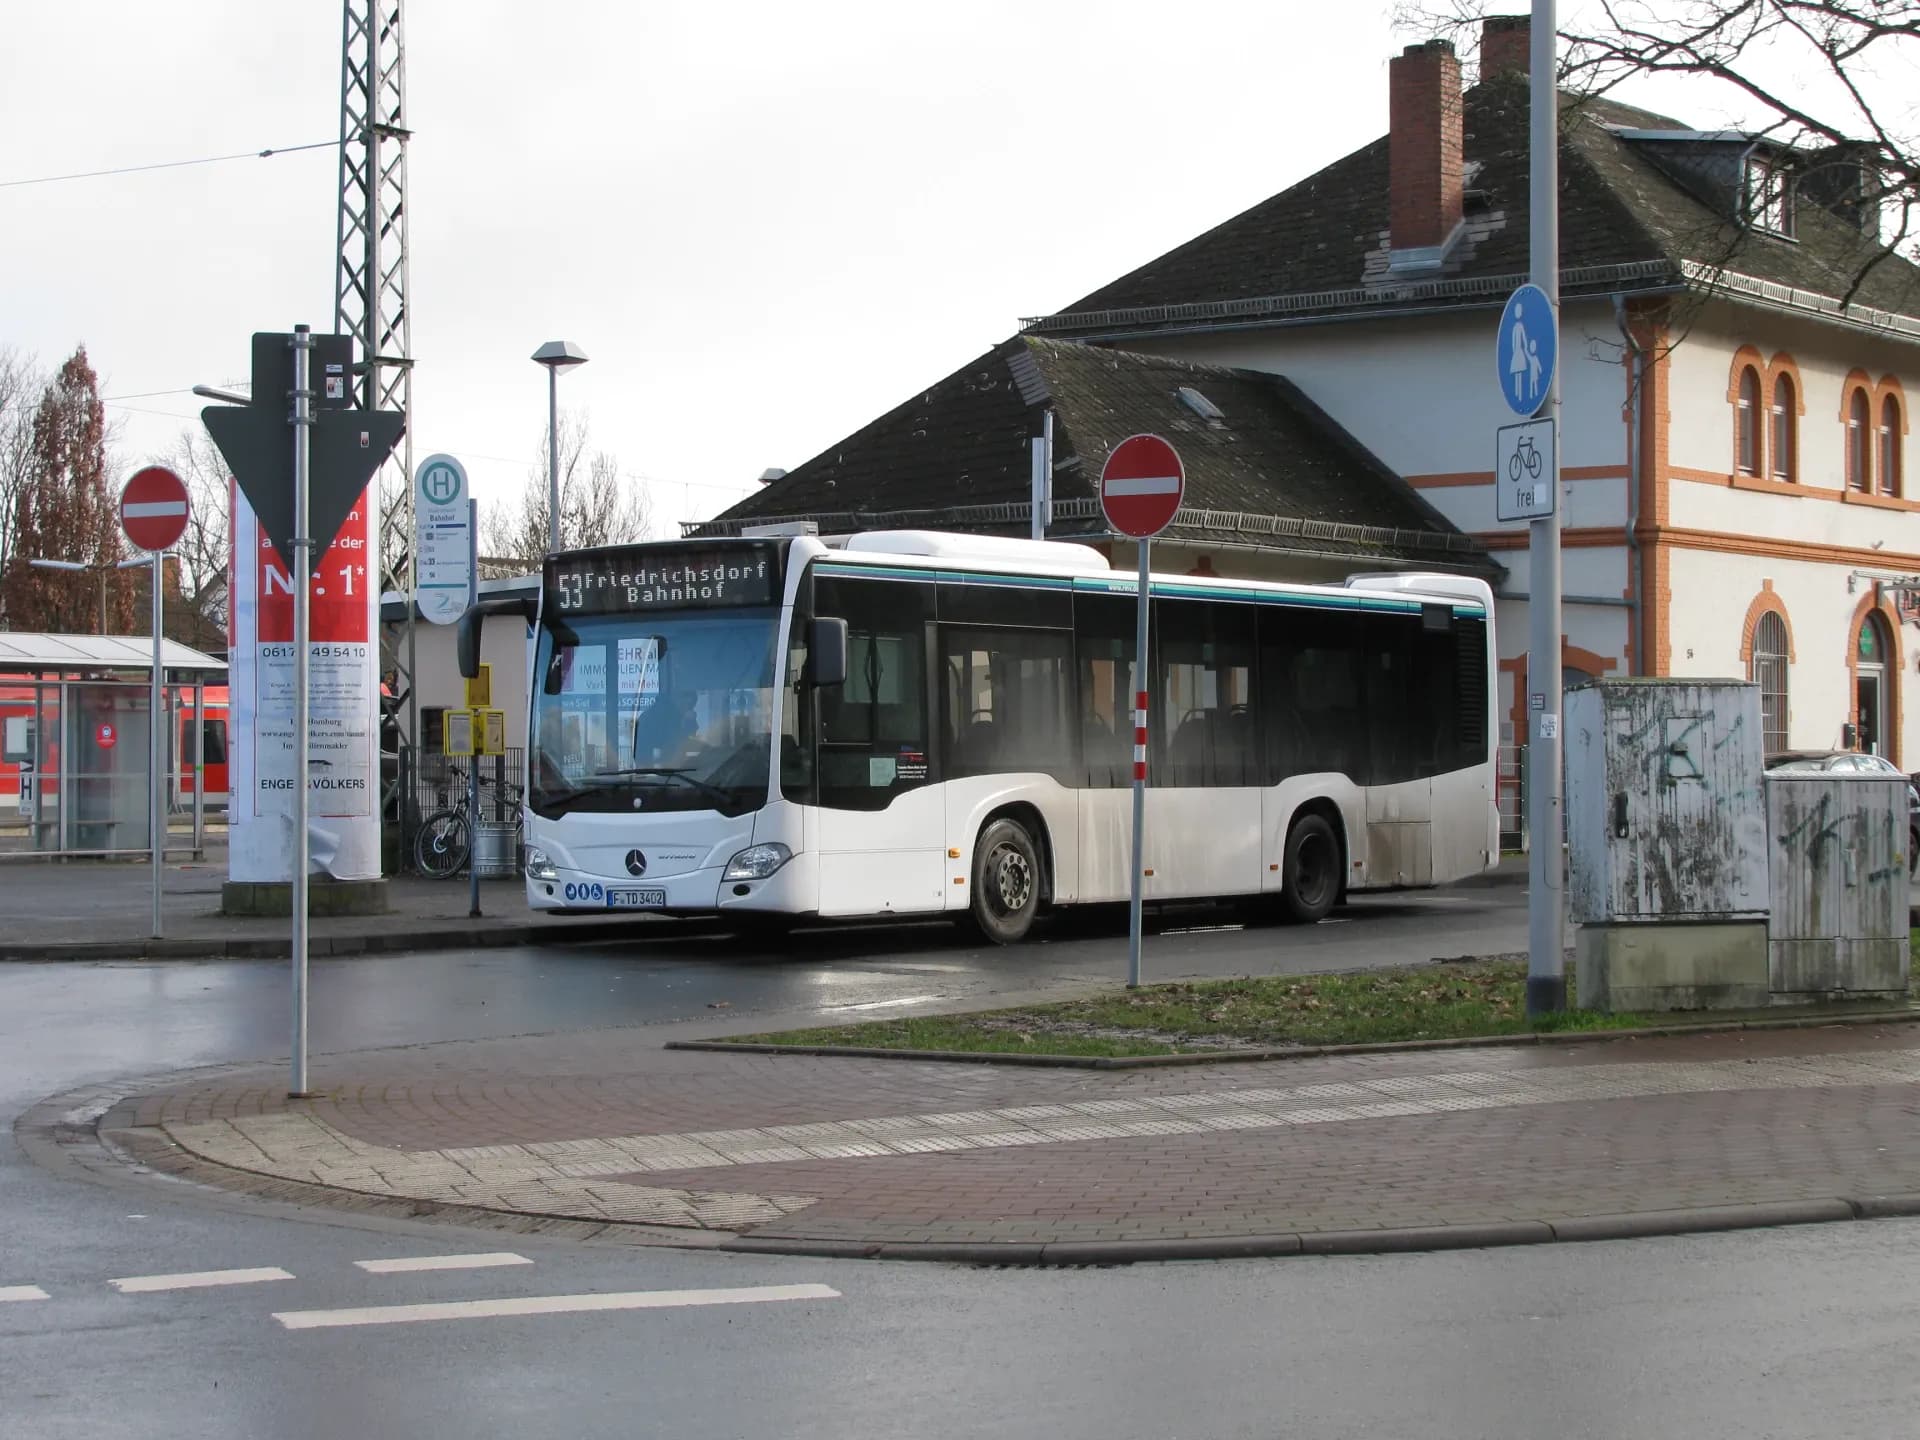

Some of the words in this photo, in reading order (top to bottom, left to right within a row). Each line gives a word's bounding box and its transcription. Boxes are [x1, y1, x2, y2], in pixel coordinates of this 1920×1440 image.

[1516, 488, 1535, 509] frei
[340, 536, 365, 549] der
[264, 564, 326, 596] N.
[558, 574, 584, 609] 53
[585, 561, 767, 589] Friedrichsdorf
[627, 582, 726, 603] Bahnhof
[262, 646, 296, 658] 0617
[311, 646, 330, 658] 49
[333, 646, 350, 658] 54
[353, 646, 366, 658] 10
[618, 647, 642, 661] EHR
[261, 779, 294, 790] ENGE
[313, 777, 366, 790] VÖLKERS
[639, 892, 663, 905] 3402
